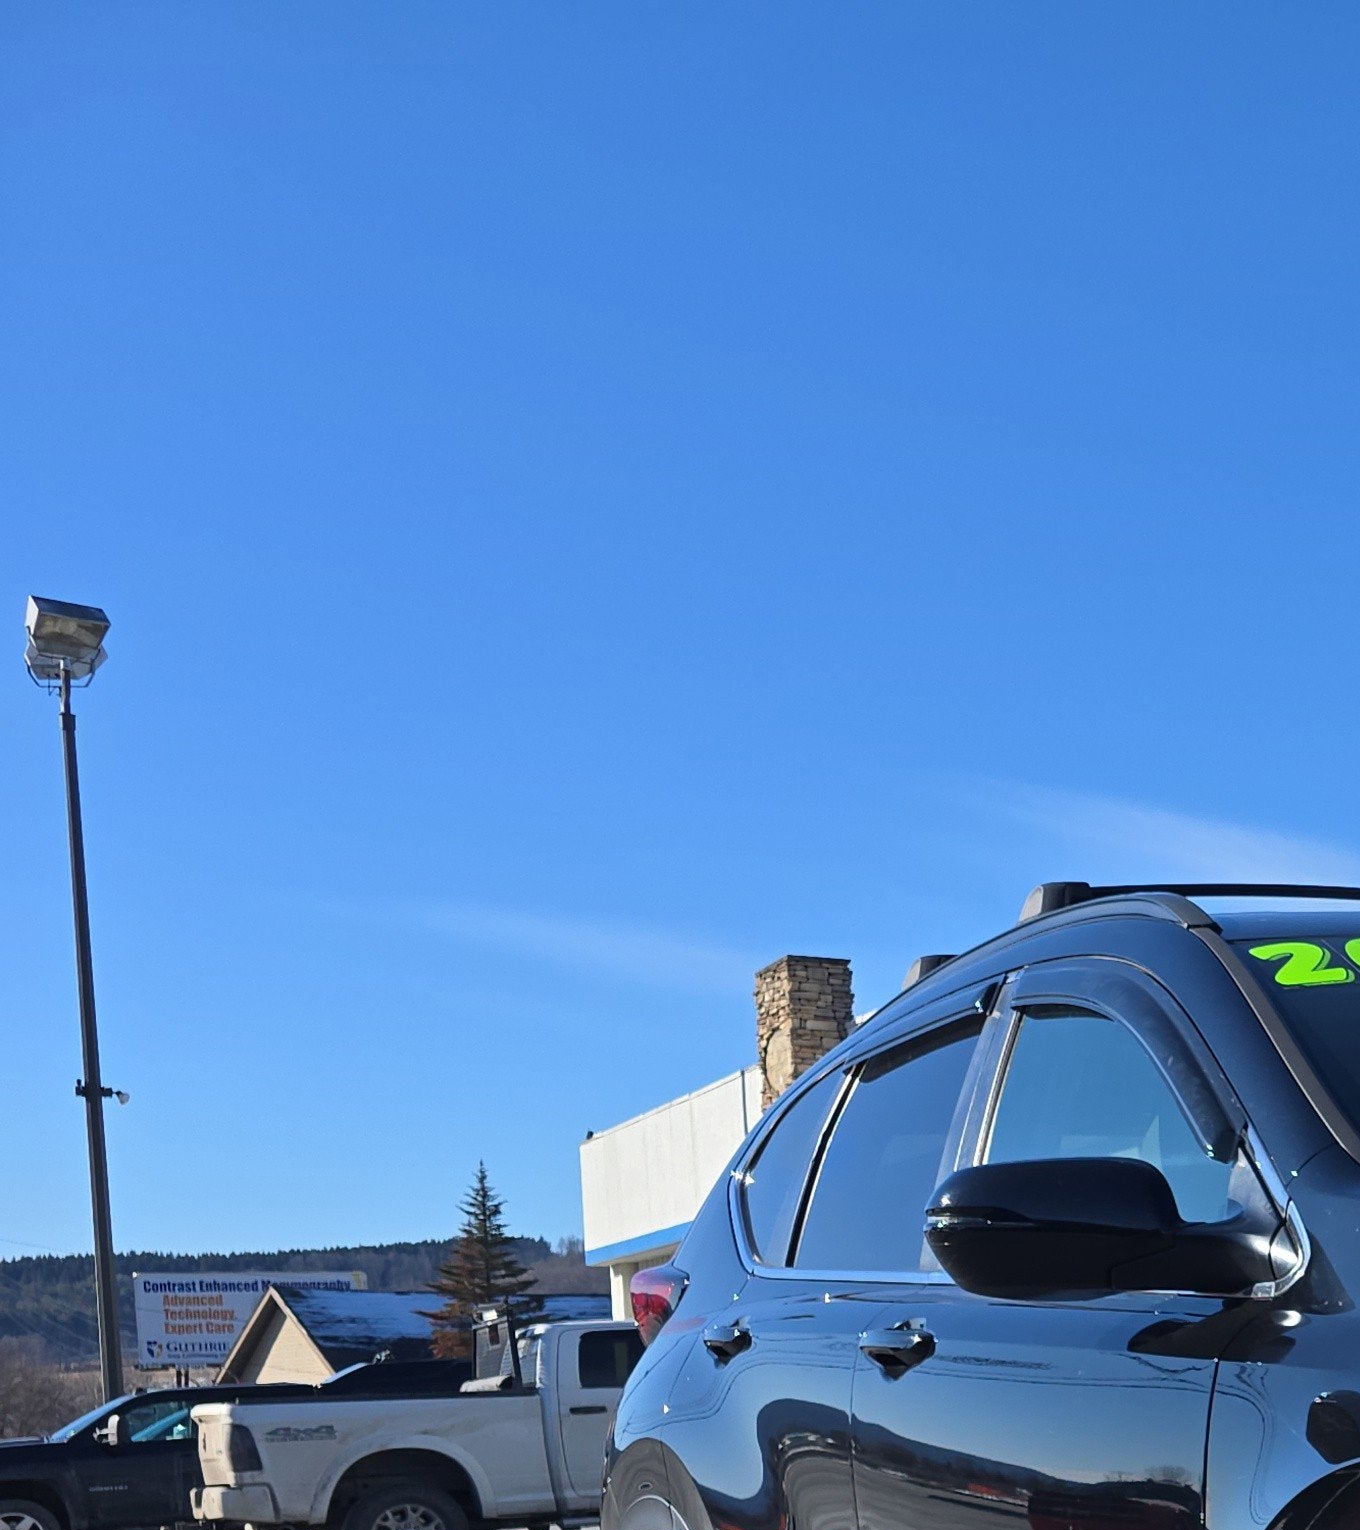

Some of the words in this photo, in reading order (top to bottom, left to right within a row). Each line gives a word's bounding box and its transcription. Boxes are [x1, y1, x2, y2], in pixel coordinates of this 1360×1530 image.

[143, 1280, 197, 1293] Contrast
[199, 1279, 259, 1292] Enhanced
[163, 1294, 223, 1306] Advanced
[164, 1323, 203, 1335] Expert
[206, 1322, 235, 1334] Care
